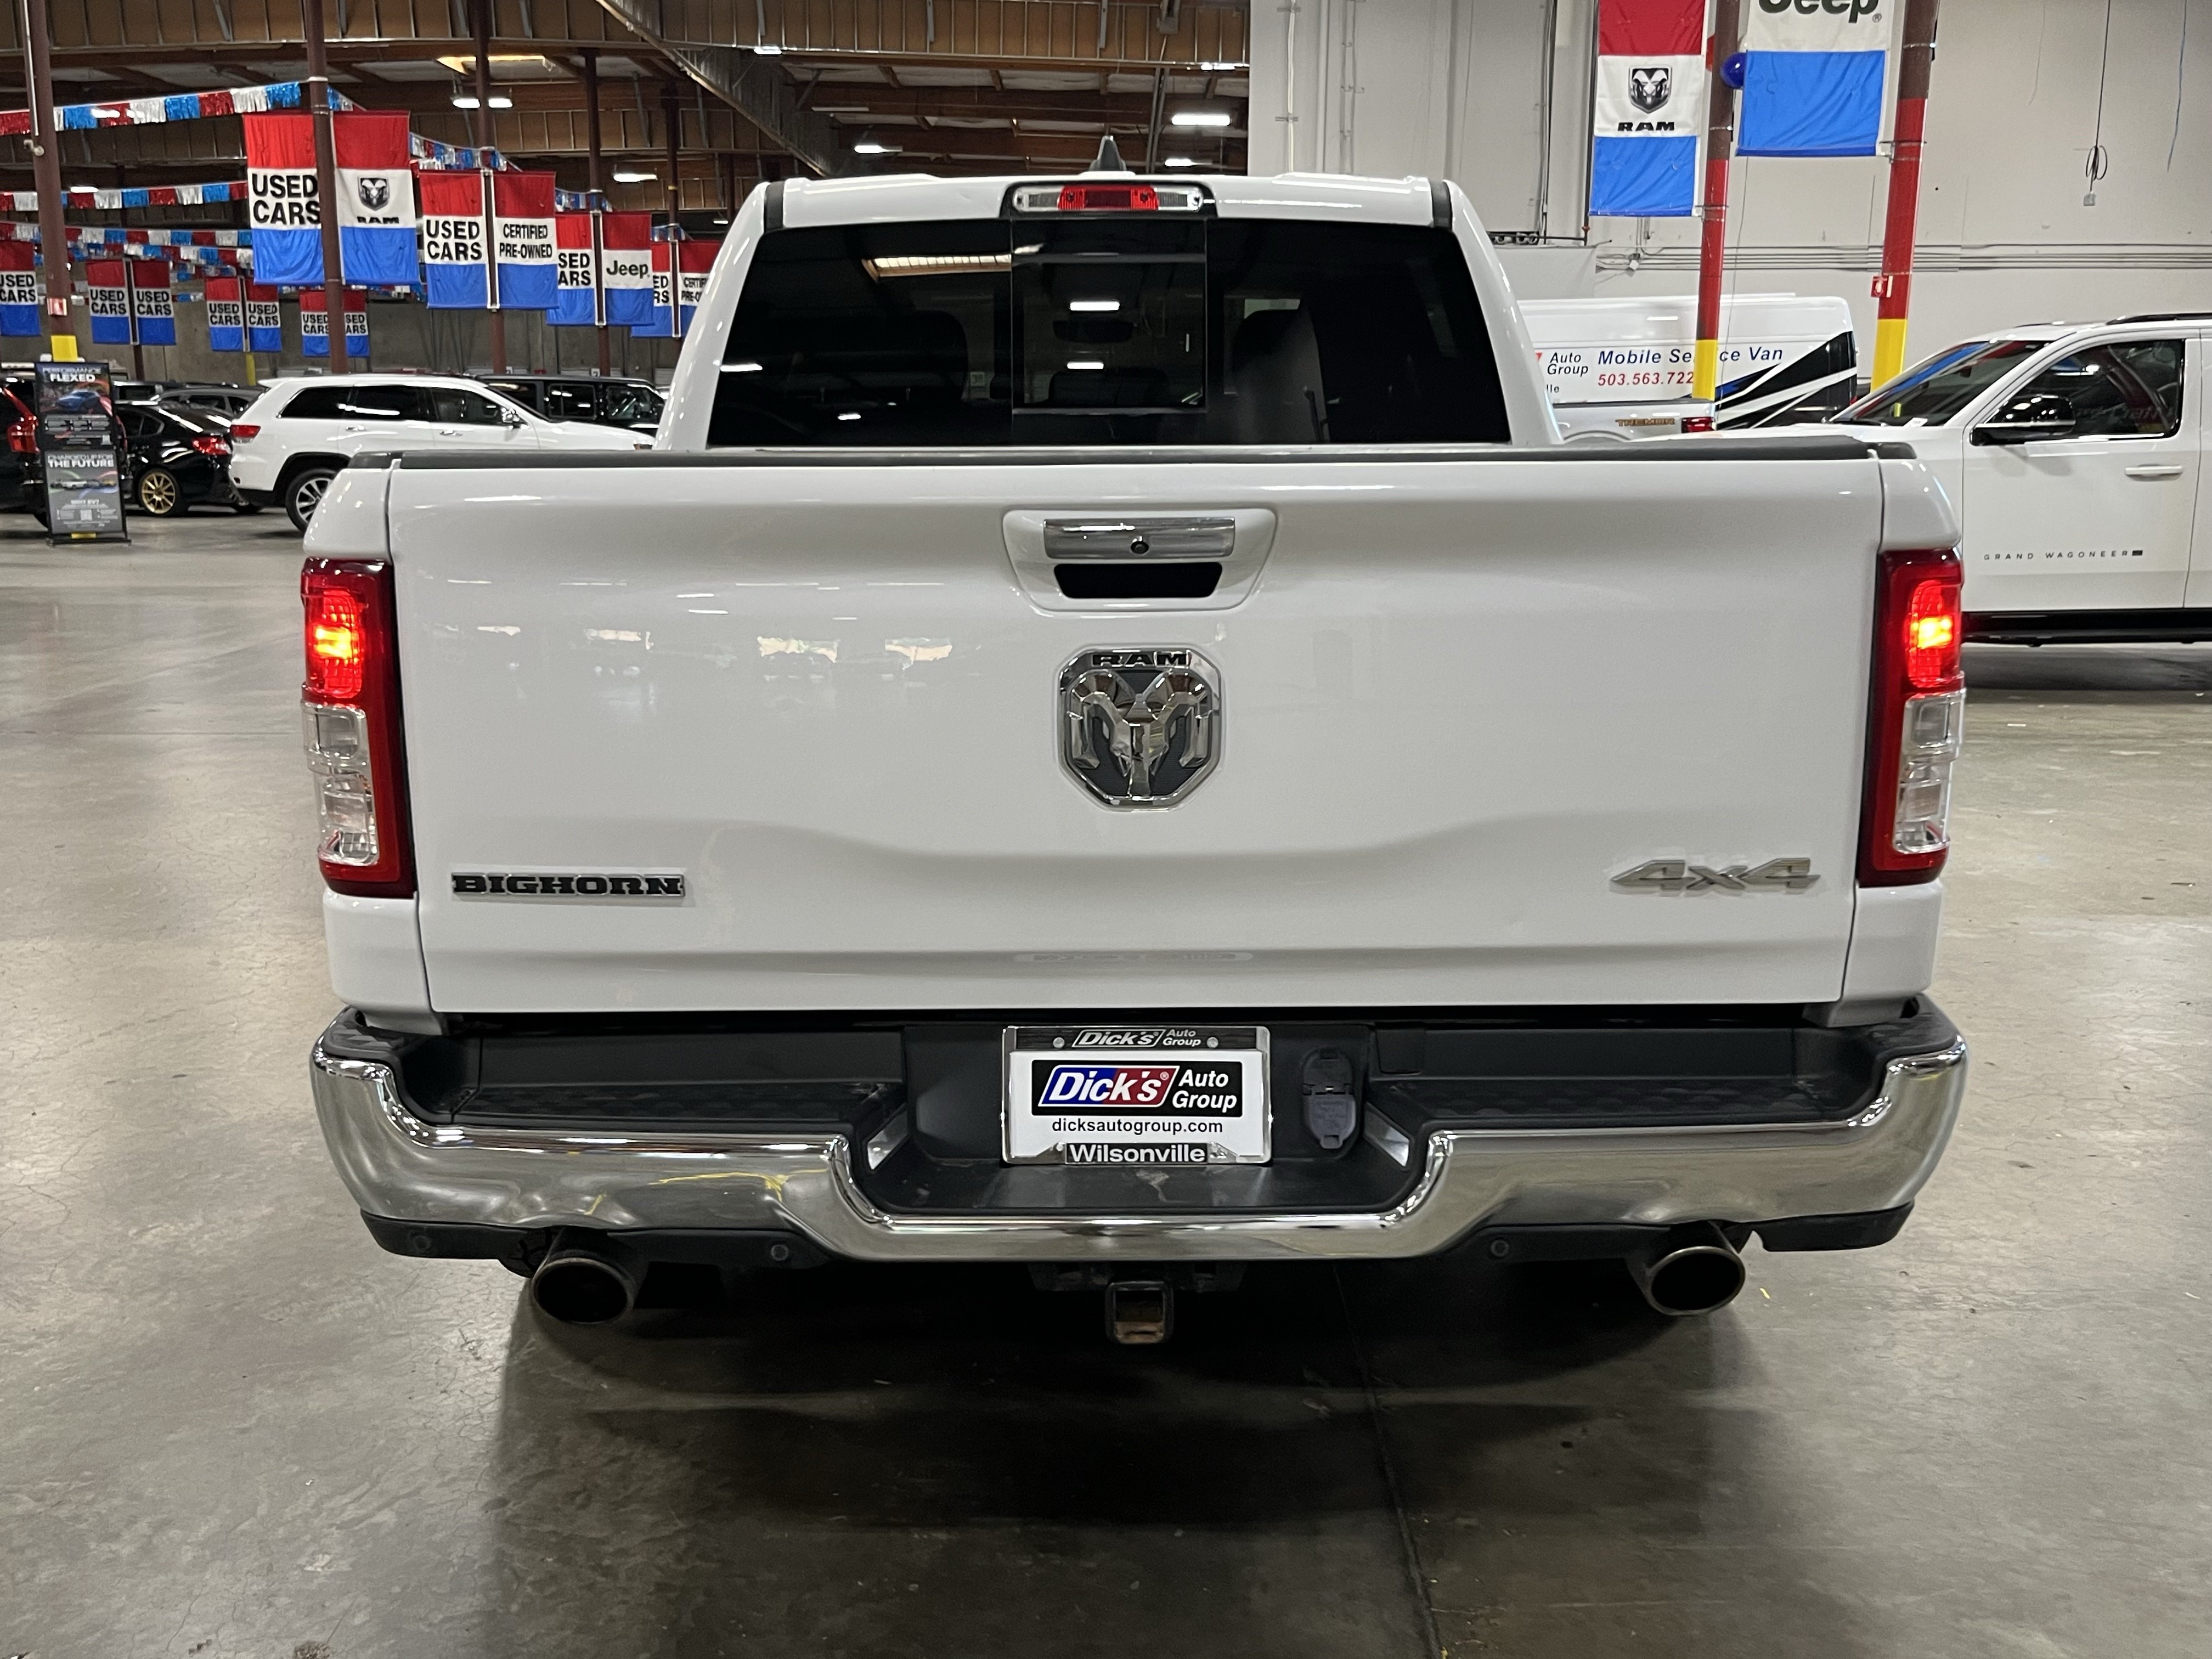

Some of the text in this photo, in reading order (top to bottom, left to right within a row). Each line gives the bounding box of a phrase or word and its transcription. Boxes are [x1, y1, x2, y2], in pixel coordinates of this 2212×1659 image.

[1618, 121, 1675, 132] RAM
[252, 174, 318, 198] USED
[253, 200, 320, 225] CARS
[357, 216, 399, 224] RAM
[426, 219, 480, 240] USED
[503, 224, 548, 239] CERTIFIED
[427, 241, 482, 261] CARS
[499, 242, 552, 258] PRE-OWNED
[558, 253, 590, 269] SED
[606, 260, 648, 279] Jeep
[558, 271, 591, 286] ARS
[653, 275, 668, 289] ED
[684, 277, 707, 287] CERTIF
[91, 289, 125, 302] USED
[137, 290, 170, 302] USED
[654, 290, 669, 303] RS
[91, 303, 127, 315] CARS
[137, 304, 172, 316] CARS
[209, 303, 239, 314] USED
[249, 303, 278, 314] USED
[210, 315, 241, 326] CARS
[249, 315, 279, 326] CARS
[345, 314, 365, 324] SED
[346, 325, 366, 334] ARS
[1549, 352, 1581, 364] Auto
[1598, 346, 1783, 365] Mobile Sece Van
[1547, 364, 1589, 377] Group
[50, 374, 95, 382] FLEXED
[1598, 371, 1694, 386] 503.563.722
[1615, 417, 1675, 427] TREMOR
[48, 460, 70, 468] THE
[2045, 550, 2128, 558] WAGONEER
[1091, 652, 1188, 668] RAM
[452, 873, 685, 896] BIGHORN
[1079, 1031, 1155, 1045] Dick's
[1163, 1037, 1201, 1047] Group
[1048, 1069, 1229, 1101] Dick's Auto
[1172, 1091, 1238, 1113] Group
[1052, 1119, 1223, 1135] dicksautogroup.com
[1069, 1144, 1205, 1163] Wilsonville
